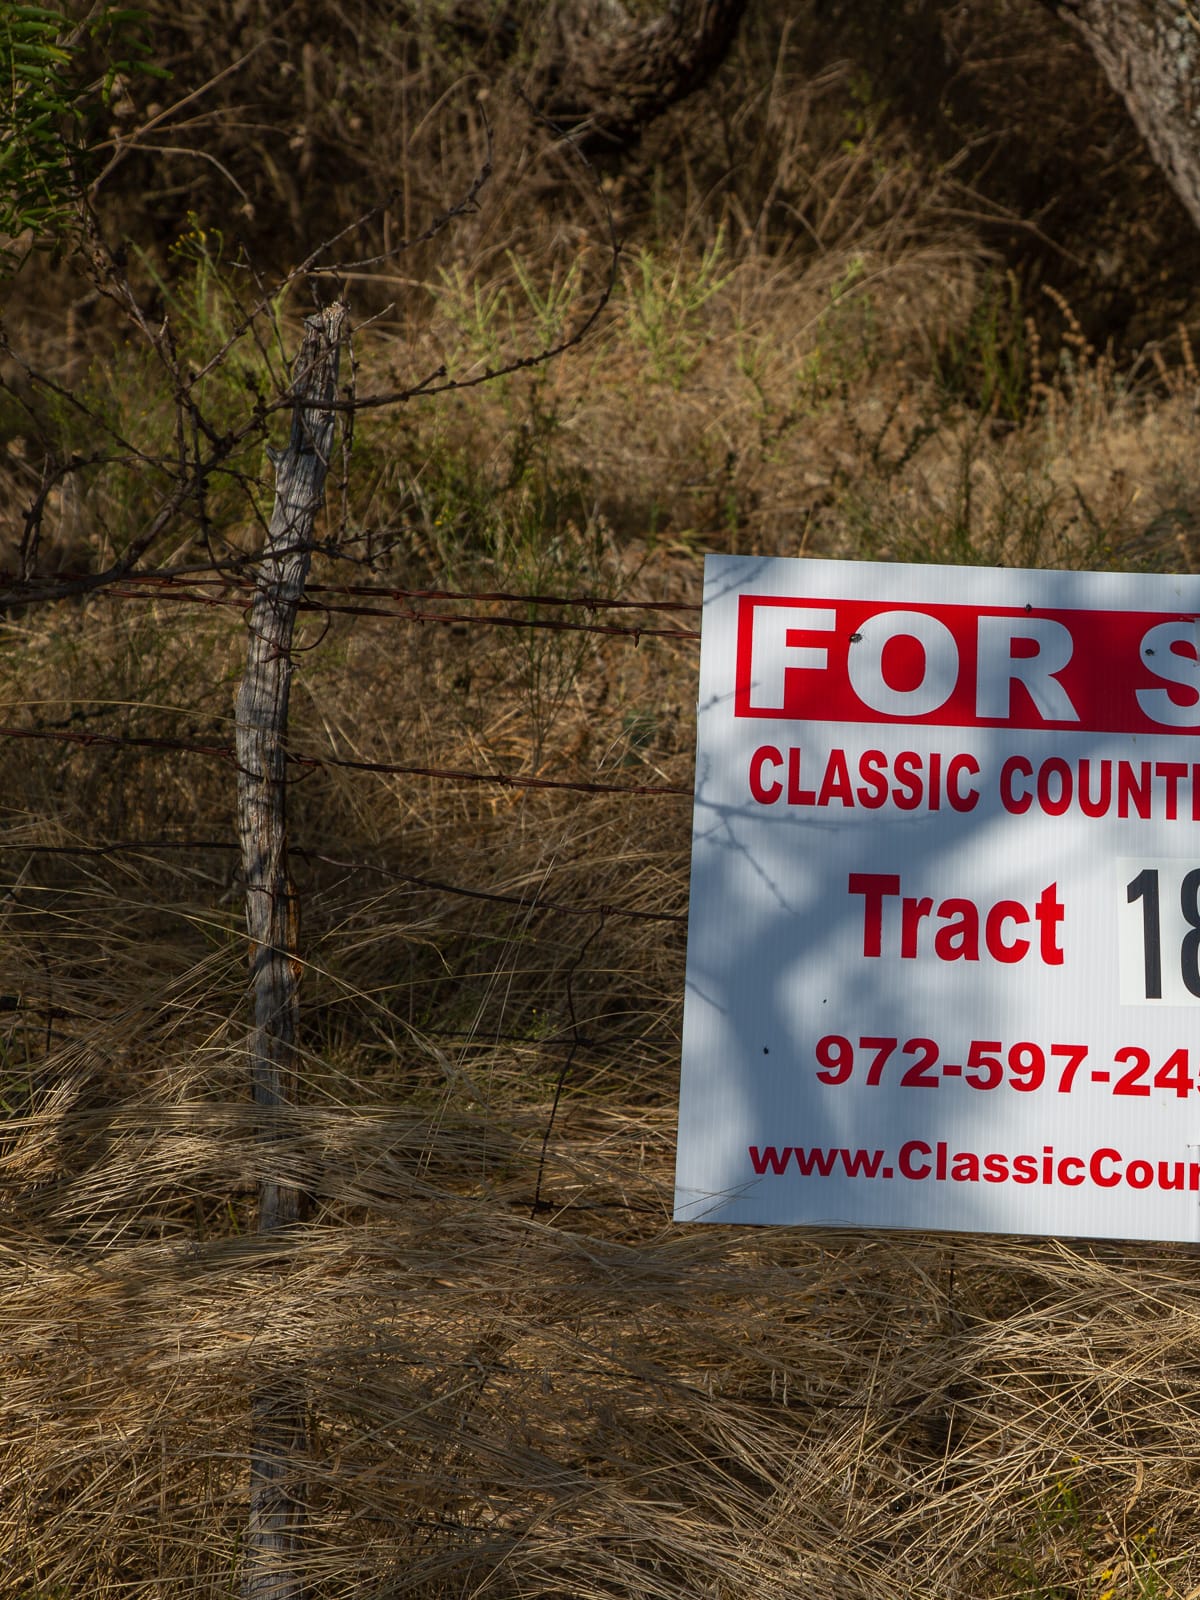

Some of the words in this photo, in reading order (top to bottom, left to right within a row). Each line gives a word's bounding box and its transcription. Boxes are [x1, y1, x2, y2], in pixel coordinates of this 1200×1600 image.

[749, 605, 1081, 723] FOR
[748, 745, 981, 813] CLASSIC
[848, 872, 1065, 966] Tract
